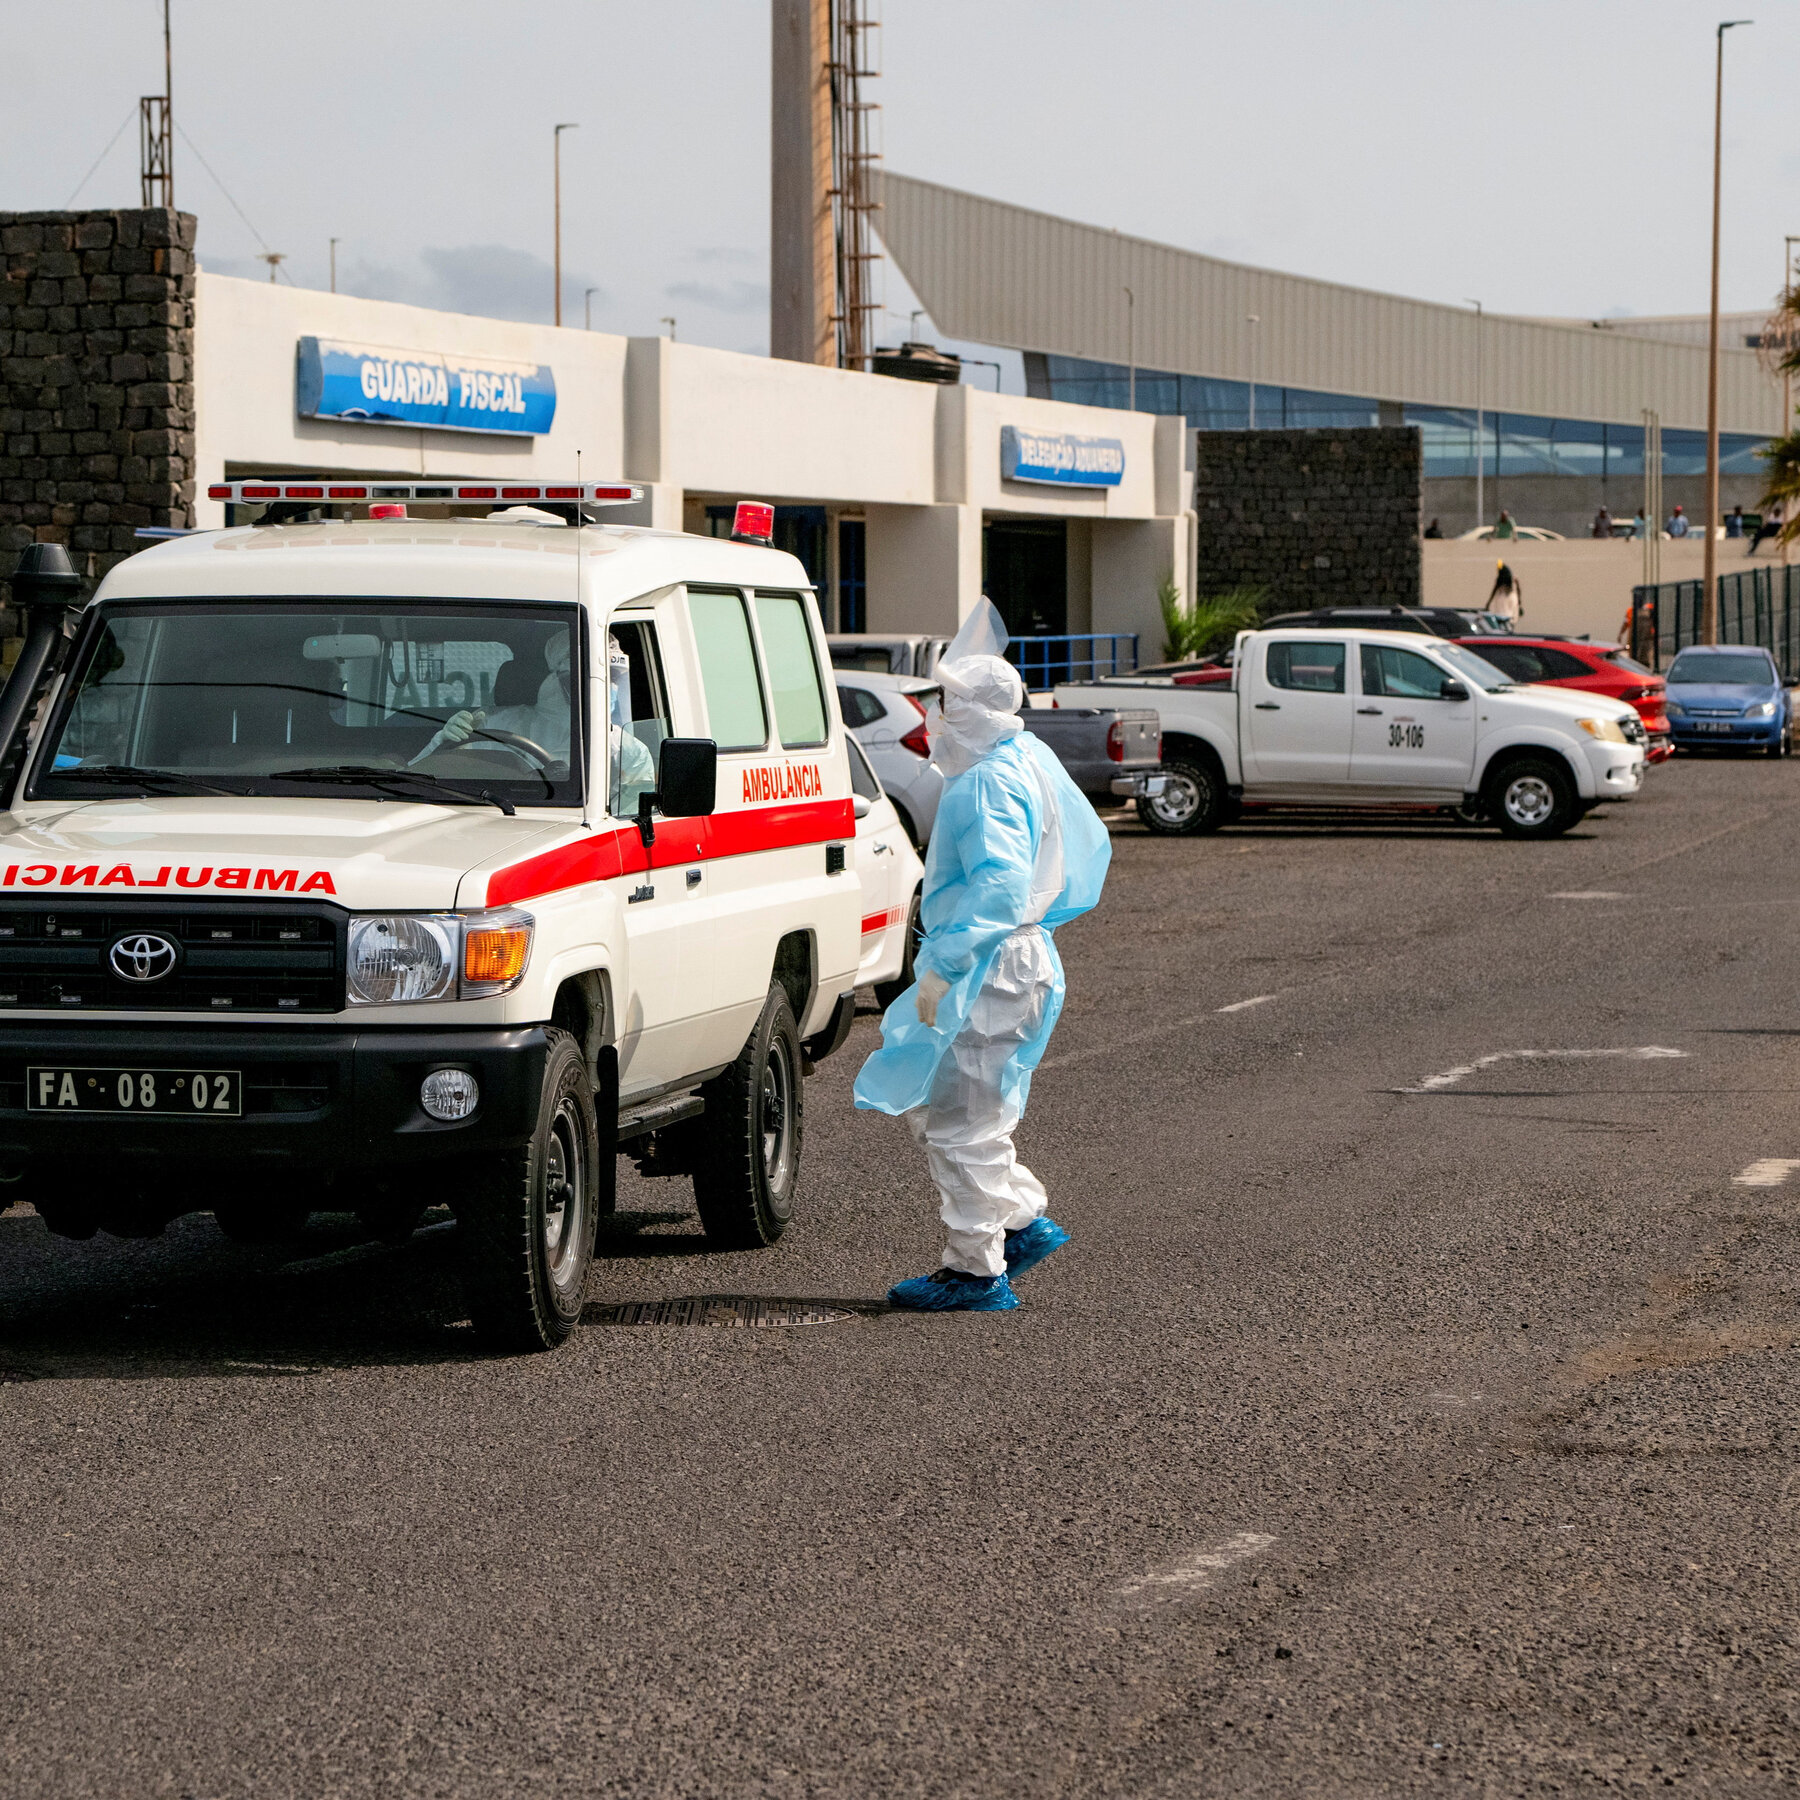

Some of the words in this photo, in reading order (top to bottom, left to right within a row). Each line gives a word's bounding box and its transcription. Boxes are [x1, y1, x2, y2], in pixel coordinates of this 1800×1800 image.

[361, 360, 449, 407] GUARDA
[458, 371, 526, 414] FISCAL
[1388, 724, 1424, 748] 30-106
[742, 759, 822, 803] AMBULÂNCIA
[39, 1072, 78, 1106] FA
[117, 1073, 156, 1108] 08
[191, 1074, 230, 1109] 02
